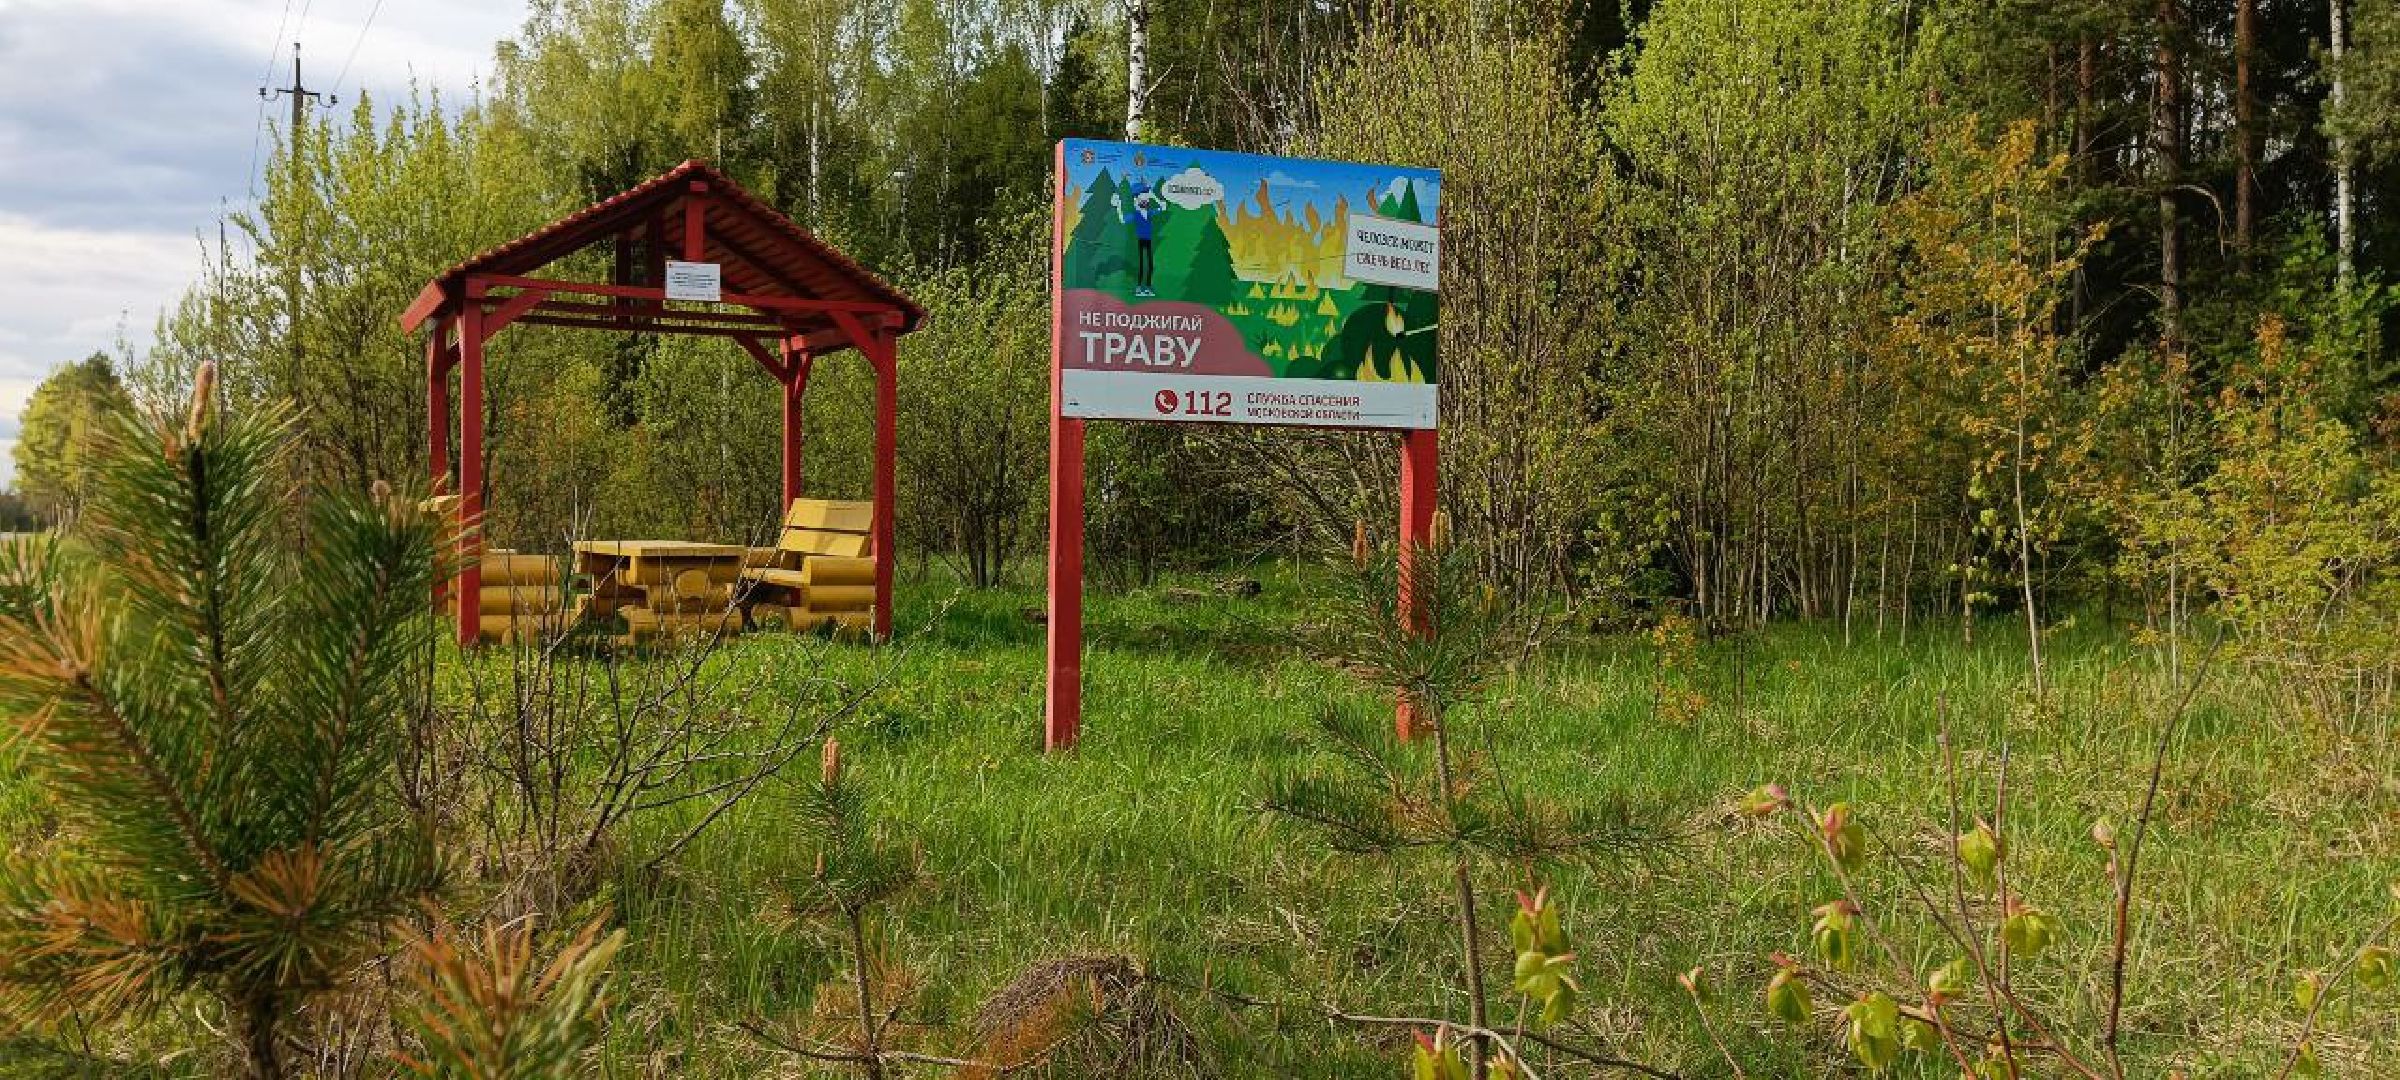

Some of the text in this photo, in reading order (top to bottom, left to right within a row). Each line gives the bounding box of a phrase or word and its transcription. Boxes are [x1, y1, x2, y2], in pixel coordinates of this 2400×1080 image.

[1079, 309, 1203, 333] НЕ ПОДЖИГАЙ
[1079, 331, 1201, 367] ТРАВУ
[1184, 390, 1233, 417] 112
[1247, 392, 1361, 408] СЛУЖБА СПАСЕНИЯ
